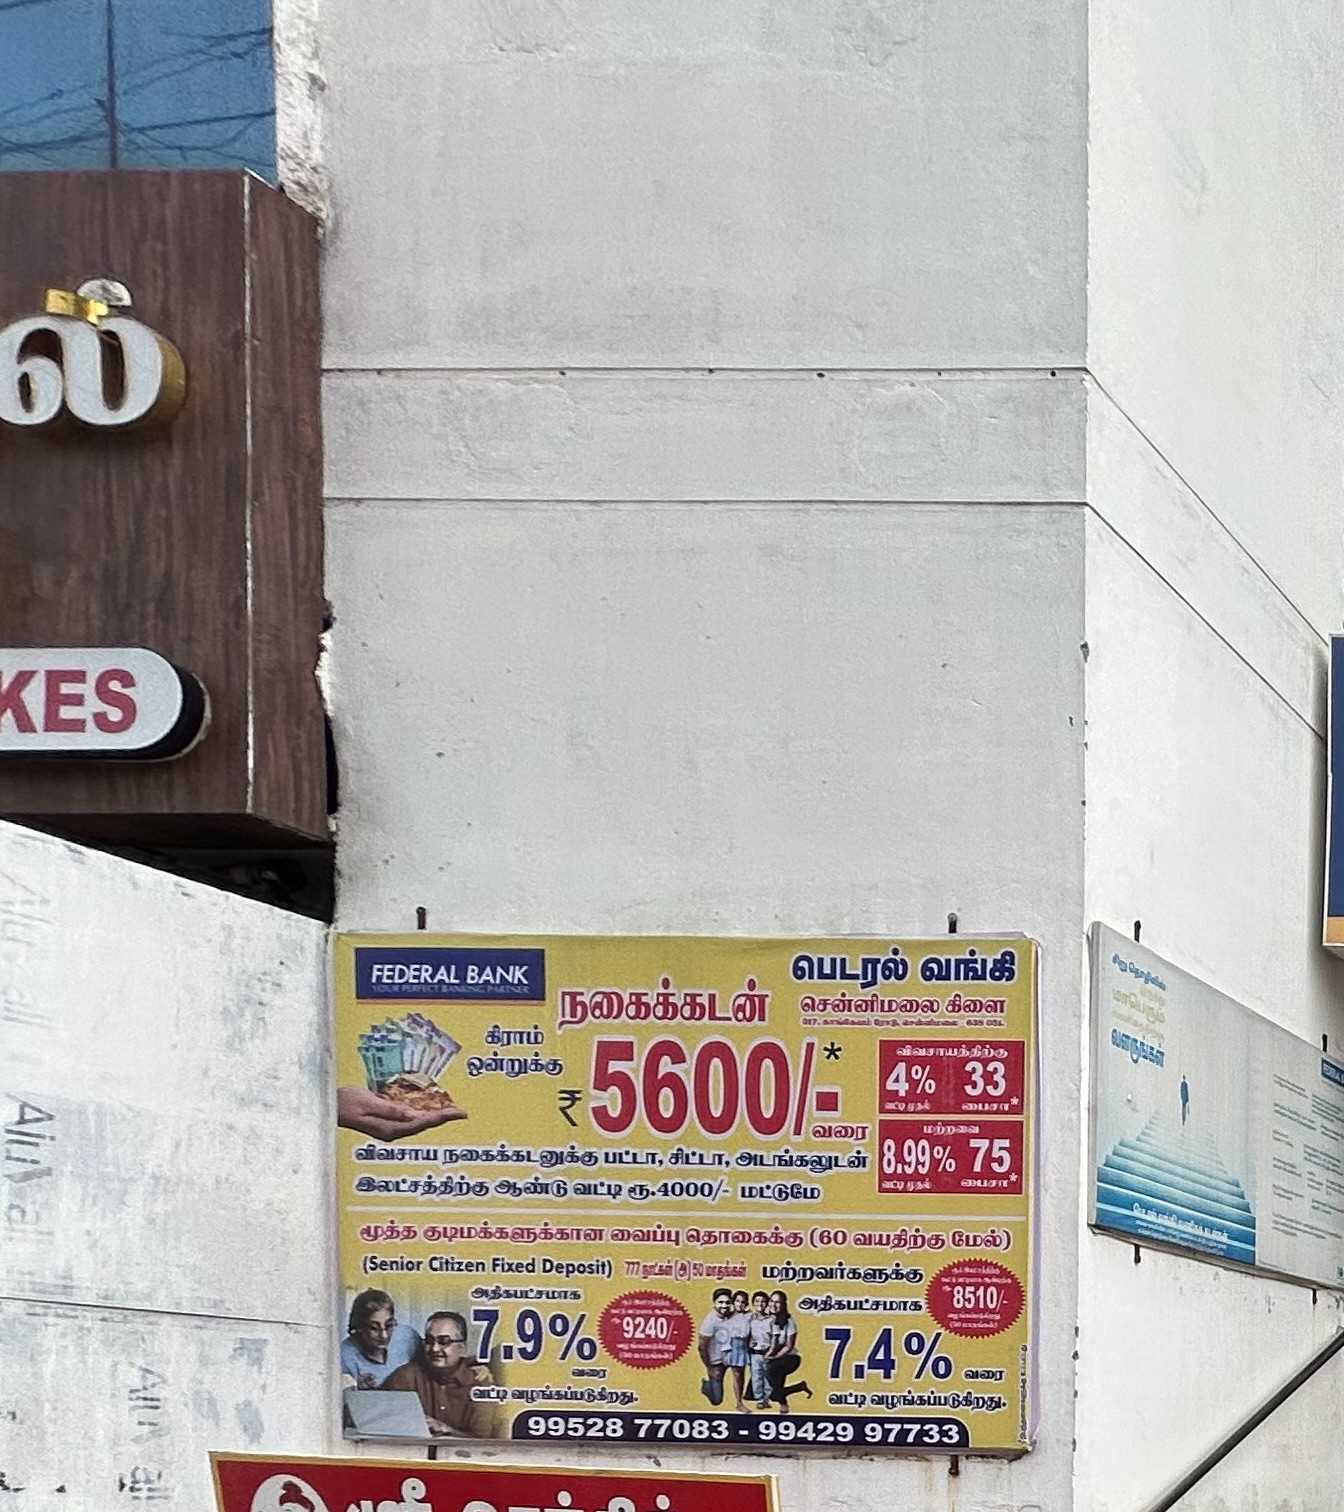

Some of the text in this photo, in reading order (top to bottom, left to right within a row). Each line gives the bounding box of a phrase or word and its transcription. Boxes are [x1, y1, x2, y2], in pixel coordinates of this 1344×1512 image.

[371, 964, 528, 985] FEDERAL BANK
[792, 947, 1016, 989] பெடரல் வங்கி
[558, 977, 768, 1030] நகைக்கடன்
[801, 992, 1006, 1013] சென்னிமலை கிளை
[485, 1025, 544, 1046] கிராம்
[467, 1051, 564, 1077] ஒன்றுக்கு
[886, 1061, 936, 1097] 4%
[964, 1060, 1006, 1096] 33
[812, 1124, 868, 1140] வரை
[356, 1144, 869, 1170] விவசாய நகைக்கடனுக்கு பட்டா, சிட்டா, அடங்கலுடன்
[969, 1138, 1011, 1173] 75
[356, 1175, 489, 1197] இலட்சத்திற்கு
[495, 1177, 567, 1197] ஆண்டு
[573, 1178, 622, 1197] வட்டி
[741, 1182, 820, 1200] மட்டுமே
[360, 1220, 1011, 1251] மூத்த குடிமக்களுக்கான வைப்பு தொகைக்கு (60 வயதிற்கு மேல்)
[363, 1256, 612, 1279] (Senior Citizen Fixed Deposit)
[762, 1261, 923, 1283] மற்றவர்களுக்கு
[471, 1286, 581, 1301] அதிகபட்சமாக
[798, 1297, 922, 1313] அதிகபட்சமாக
[472, 1307, 598, 1363] 7.9%
[825, 1327, 952, 1380] 7.4%
[528, 1416, 960, 1443] 99528 77083 99429 97733
